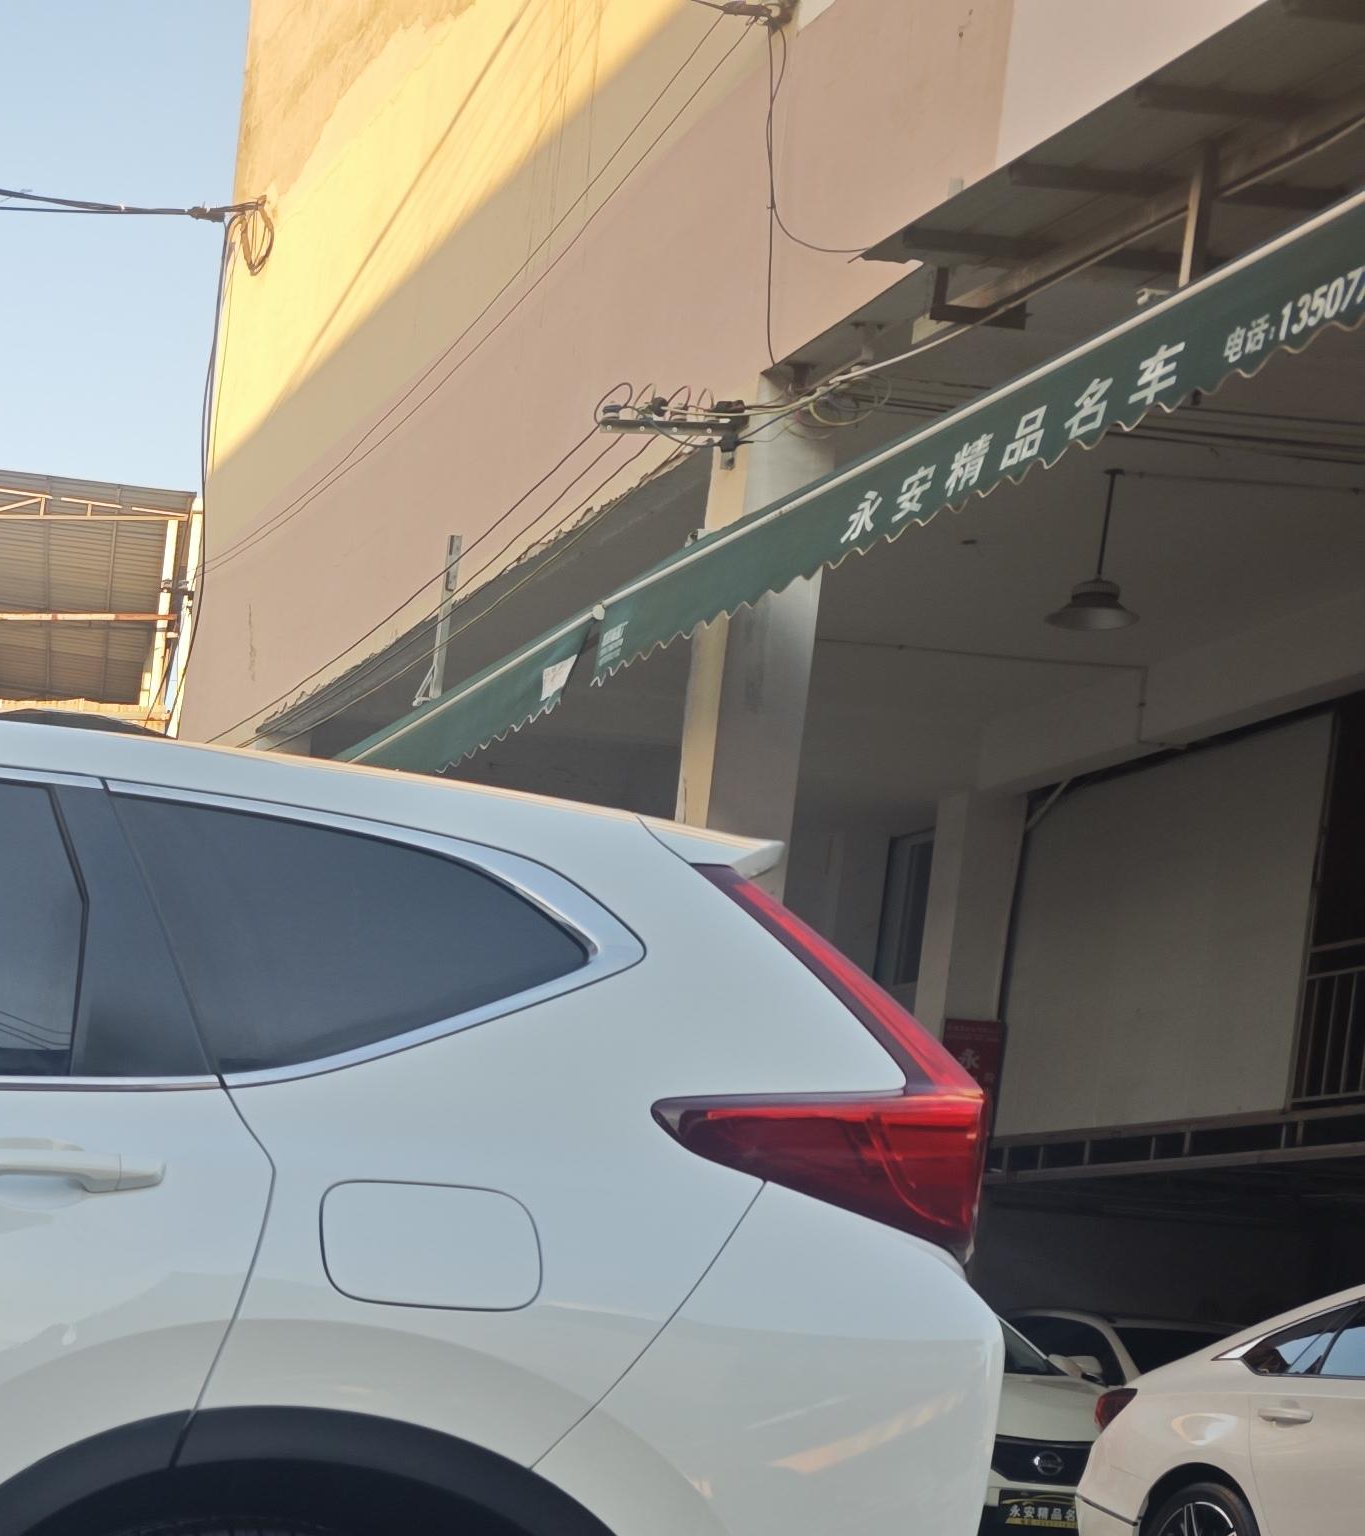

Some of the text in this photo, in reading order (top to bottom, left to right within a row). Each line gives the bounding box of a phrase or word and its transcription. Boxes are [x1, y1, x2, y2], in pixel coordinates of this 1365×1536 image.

[840, 341, 1186, 544] 永安精品名车
